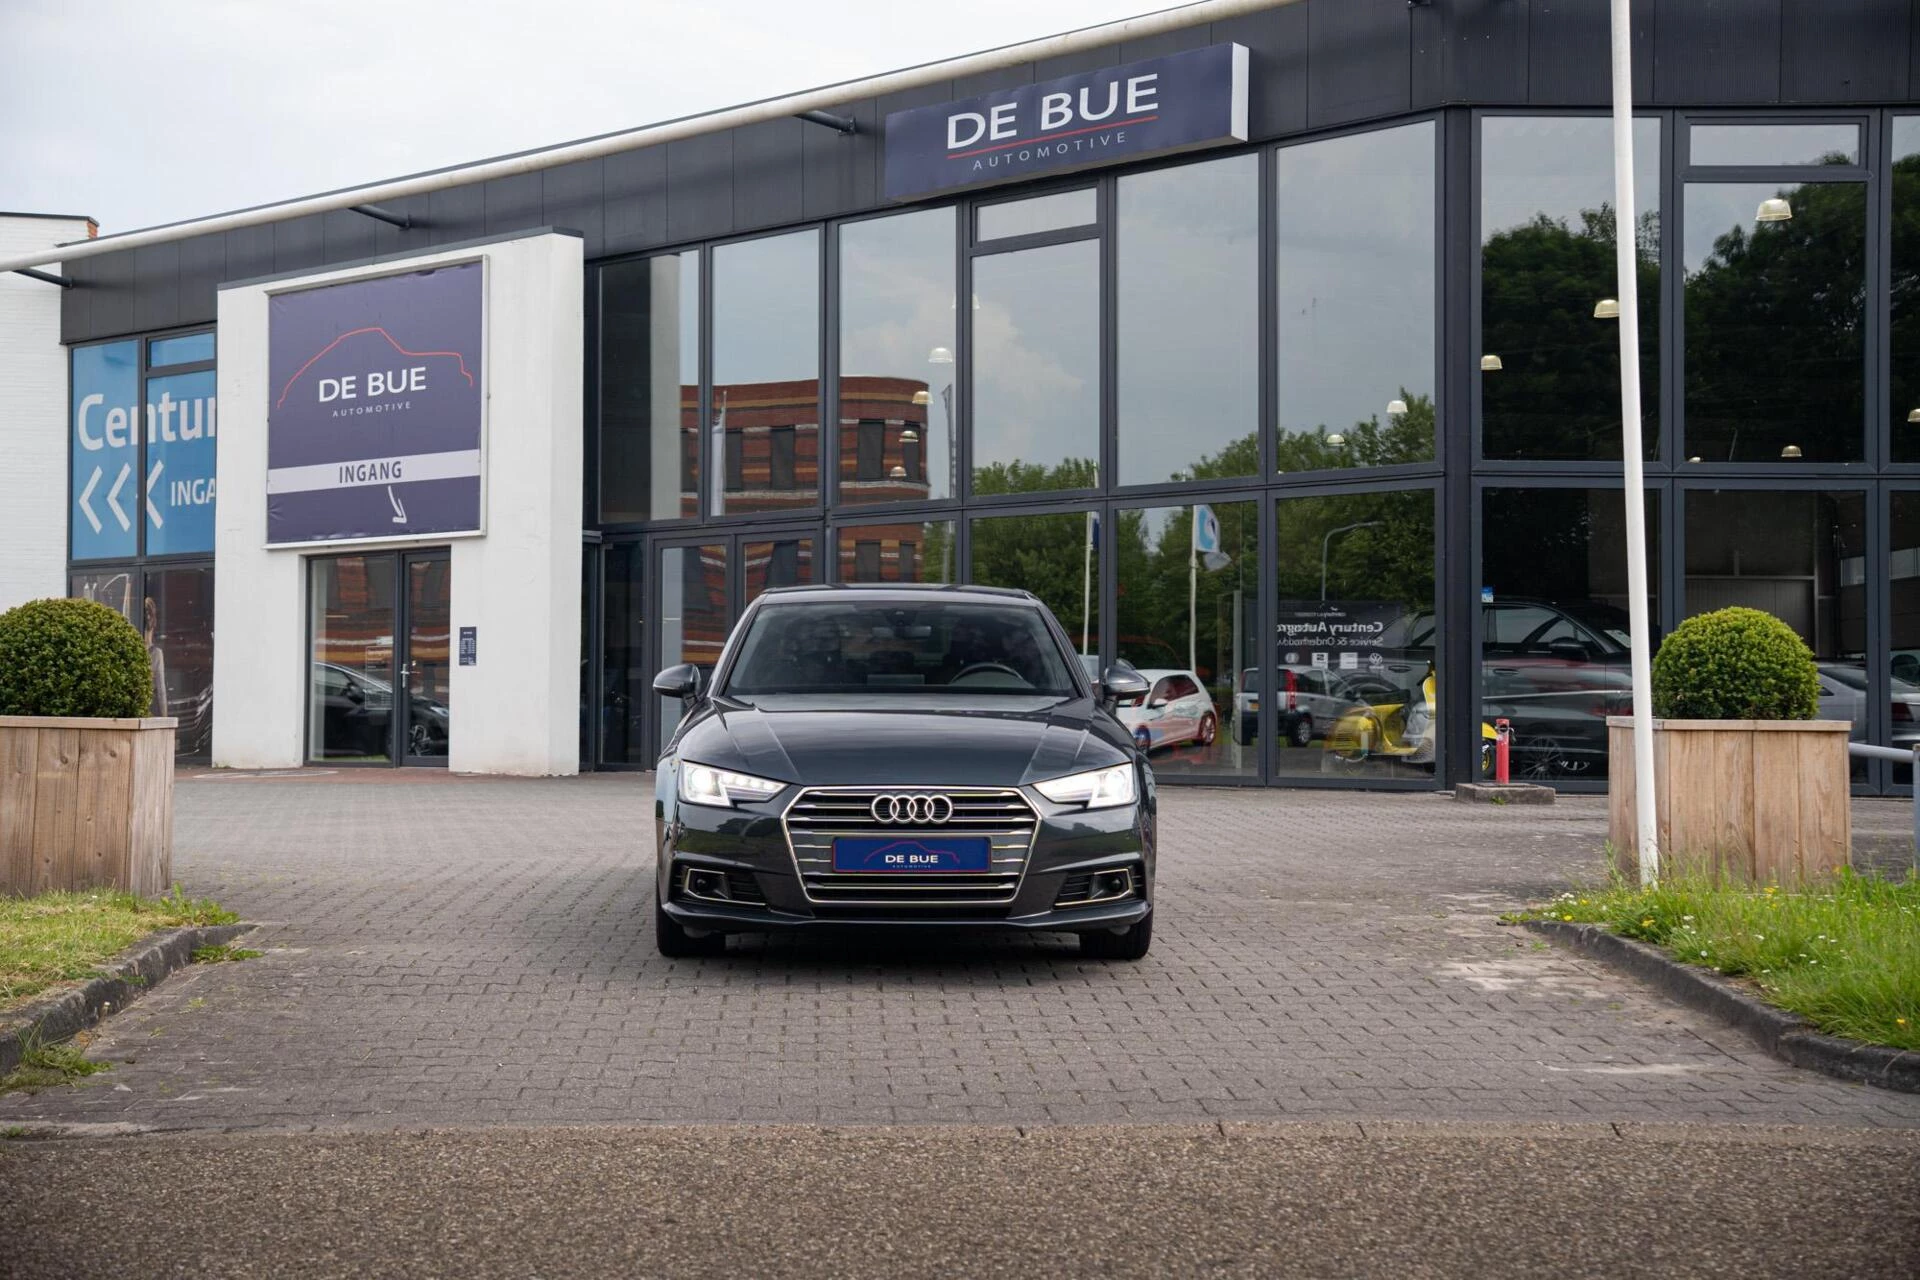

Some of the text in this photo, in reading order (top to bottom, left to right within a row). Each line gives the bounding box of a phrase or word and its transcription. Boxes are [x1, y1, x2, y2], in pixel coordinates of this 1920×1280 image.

[947, 73, 1159, 149] DE BUE
[973, 131, 1126, 171] AUTOMOTIVE
[319, 366, 427, 402] DE BUE
[332, 401, 412, 418] AUTOMOTIVE
[339, 461, 402, 483] INGANG
[885, 854, 939, 864] DE BUE
